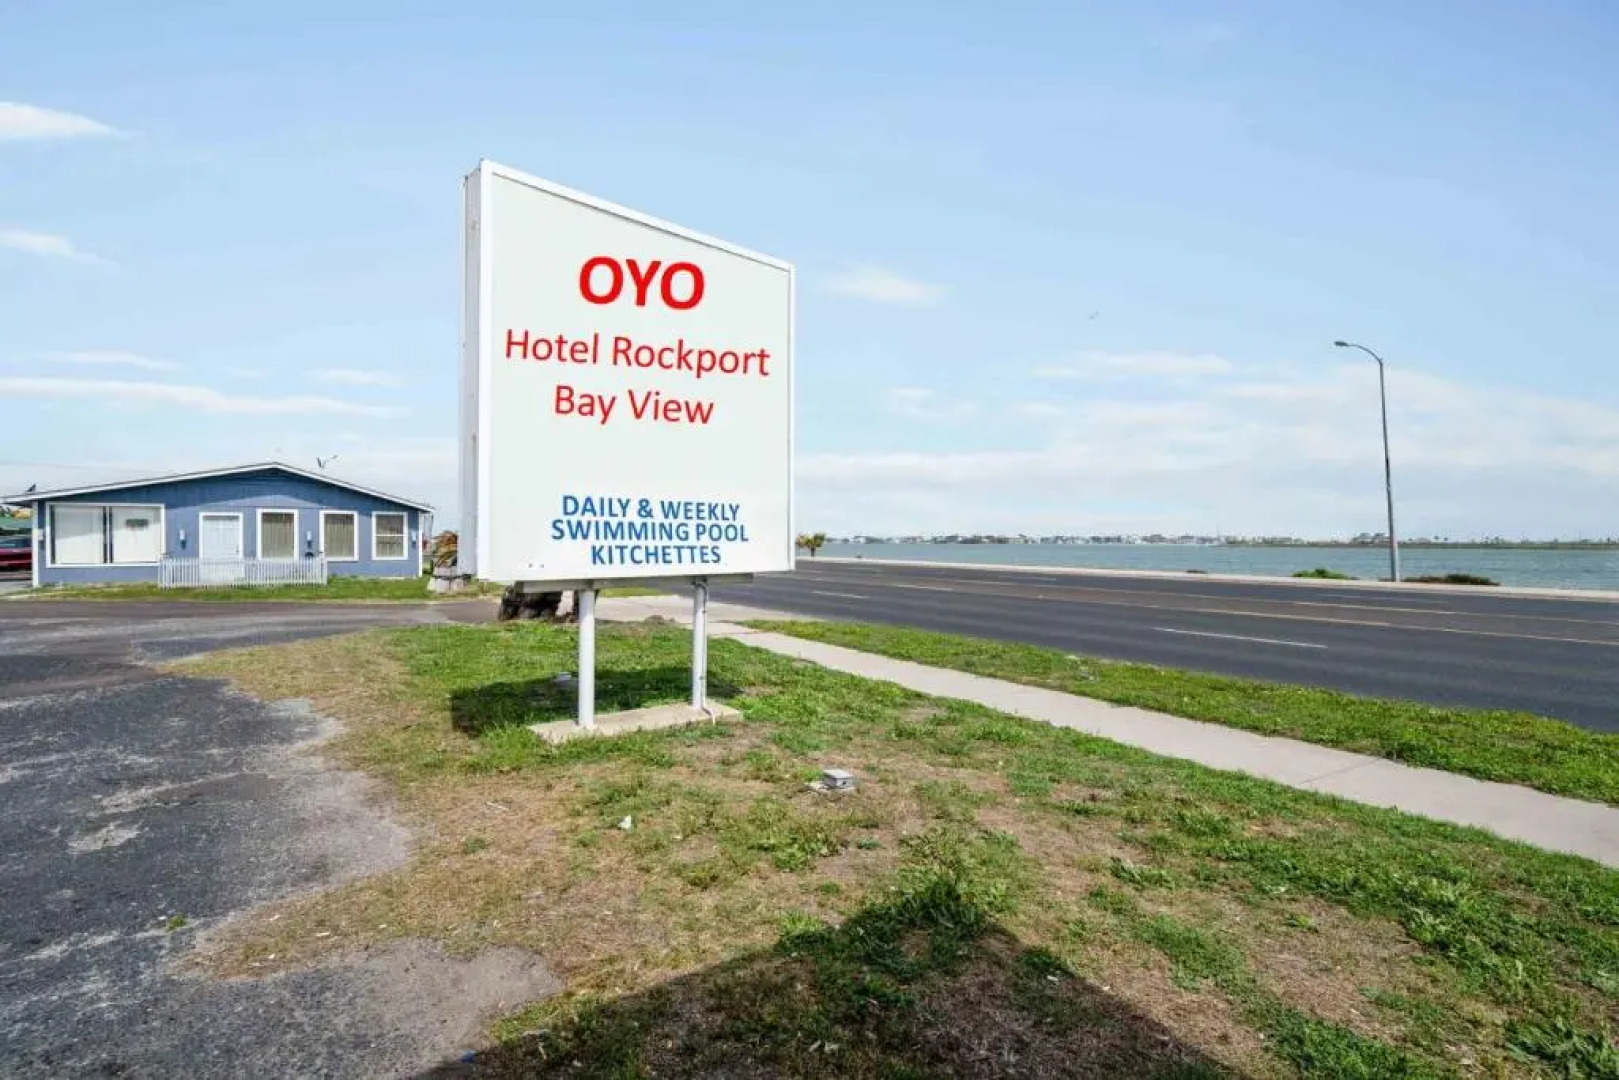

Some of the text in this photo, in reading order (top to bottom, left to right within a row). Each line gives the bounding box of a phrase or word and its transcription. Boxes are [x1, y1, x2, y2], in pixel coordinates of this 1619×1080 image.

[578, 256, 706, 310] OYO
[505, 330, 770, 378] Hotel Rockport
[554, 385, 714, 425] Bay View
[562, 495, 740, 521] DAILY & WEEKLY
[551, 519, 749, 542] SWIMMING POOL
[591, 545, 721, 565] KITCHETTES
